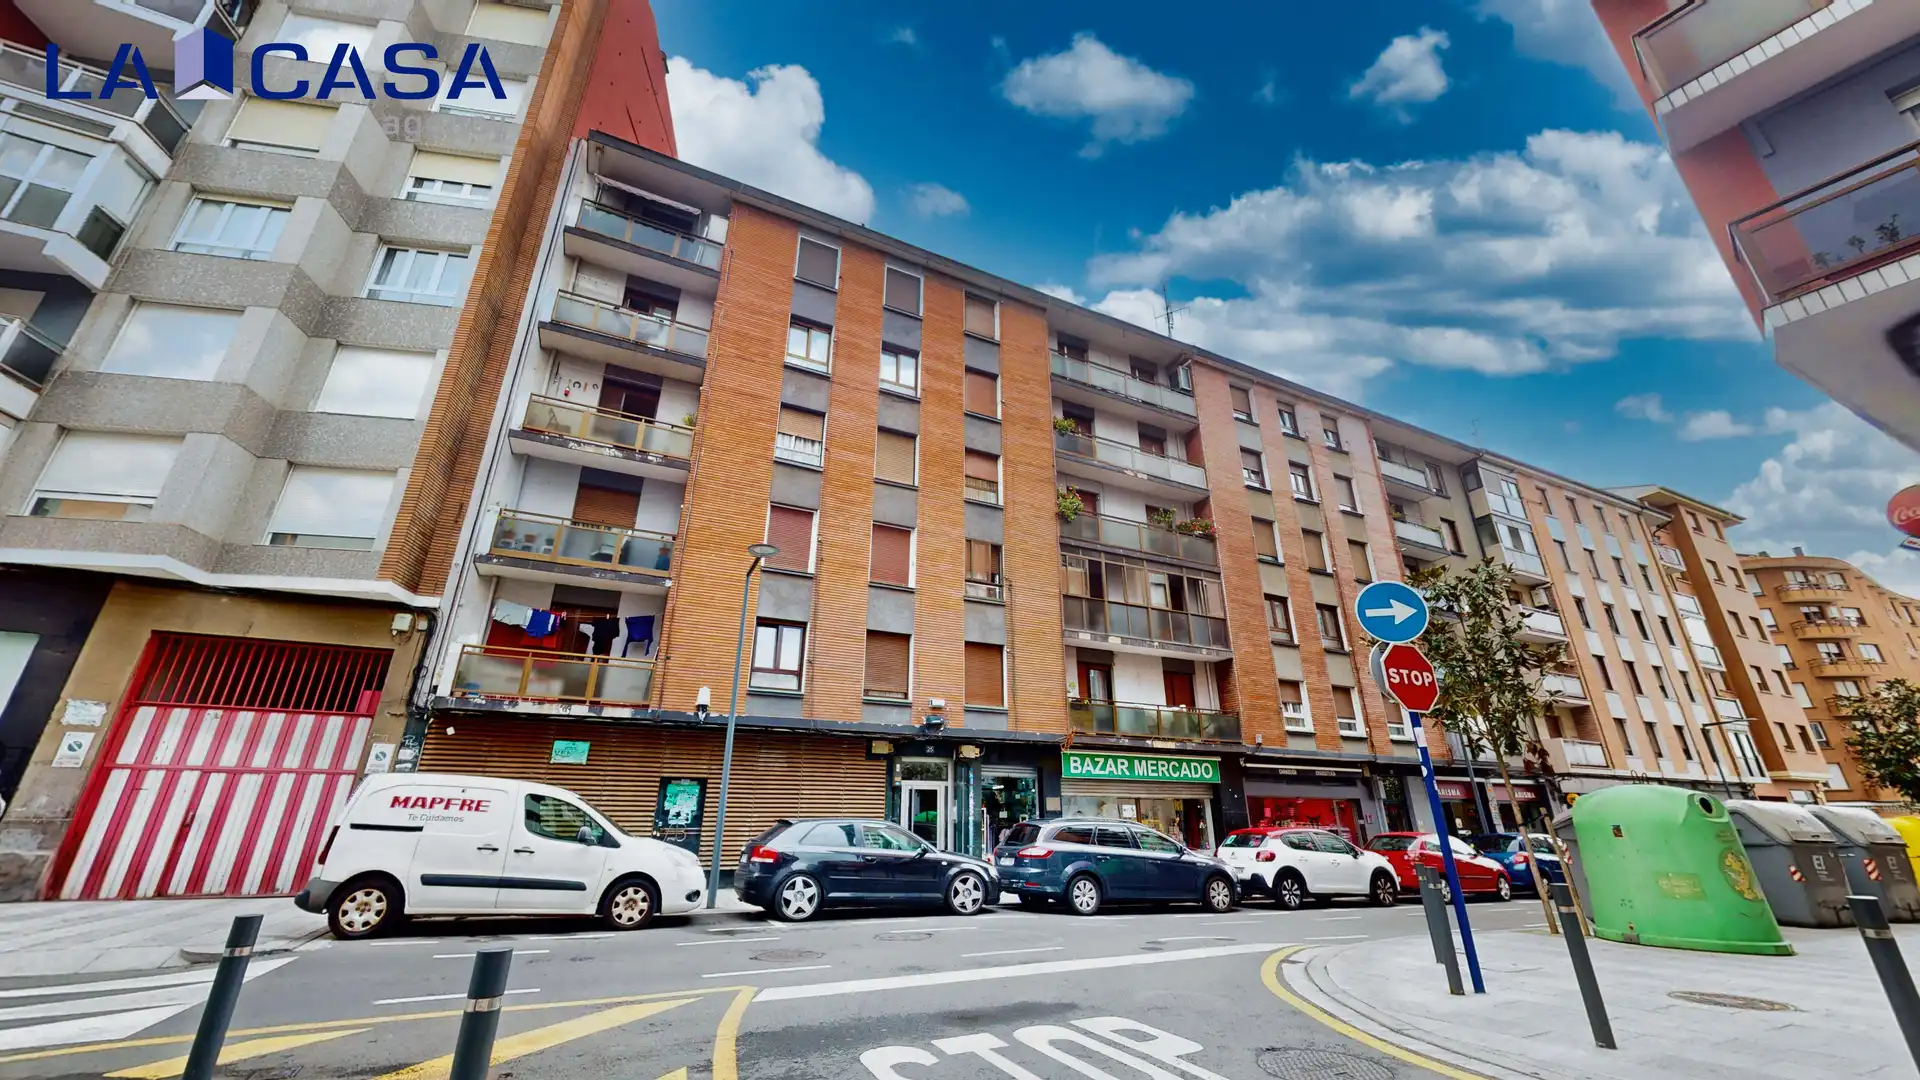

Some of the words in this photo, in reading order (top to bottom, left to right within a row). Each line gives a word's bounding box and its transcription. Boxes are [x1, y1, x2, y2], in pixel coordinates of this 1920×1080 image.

[1388, 667, 1433, 687] STOP
[1069, 756, 1130, 776] BAZAR
[1134, 759, 1213, 779] MERCADO
[389, 796, 492, 813] MAPFRE
[408, 813, 417, 821] Te
[419, 813, 465, 822] Cuidamos
